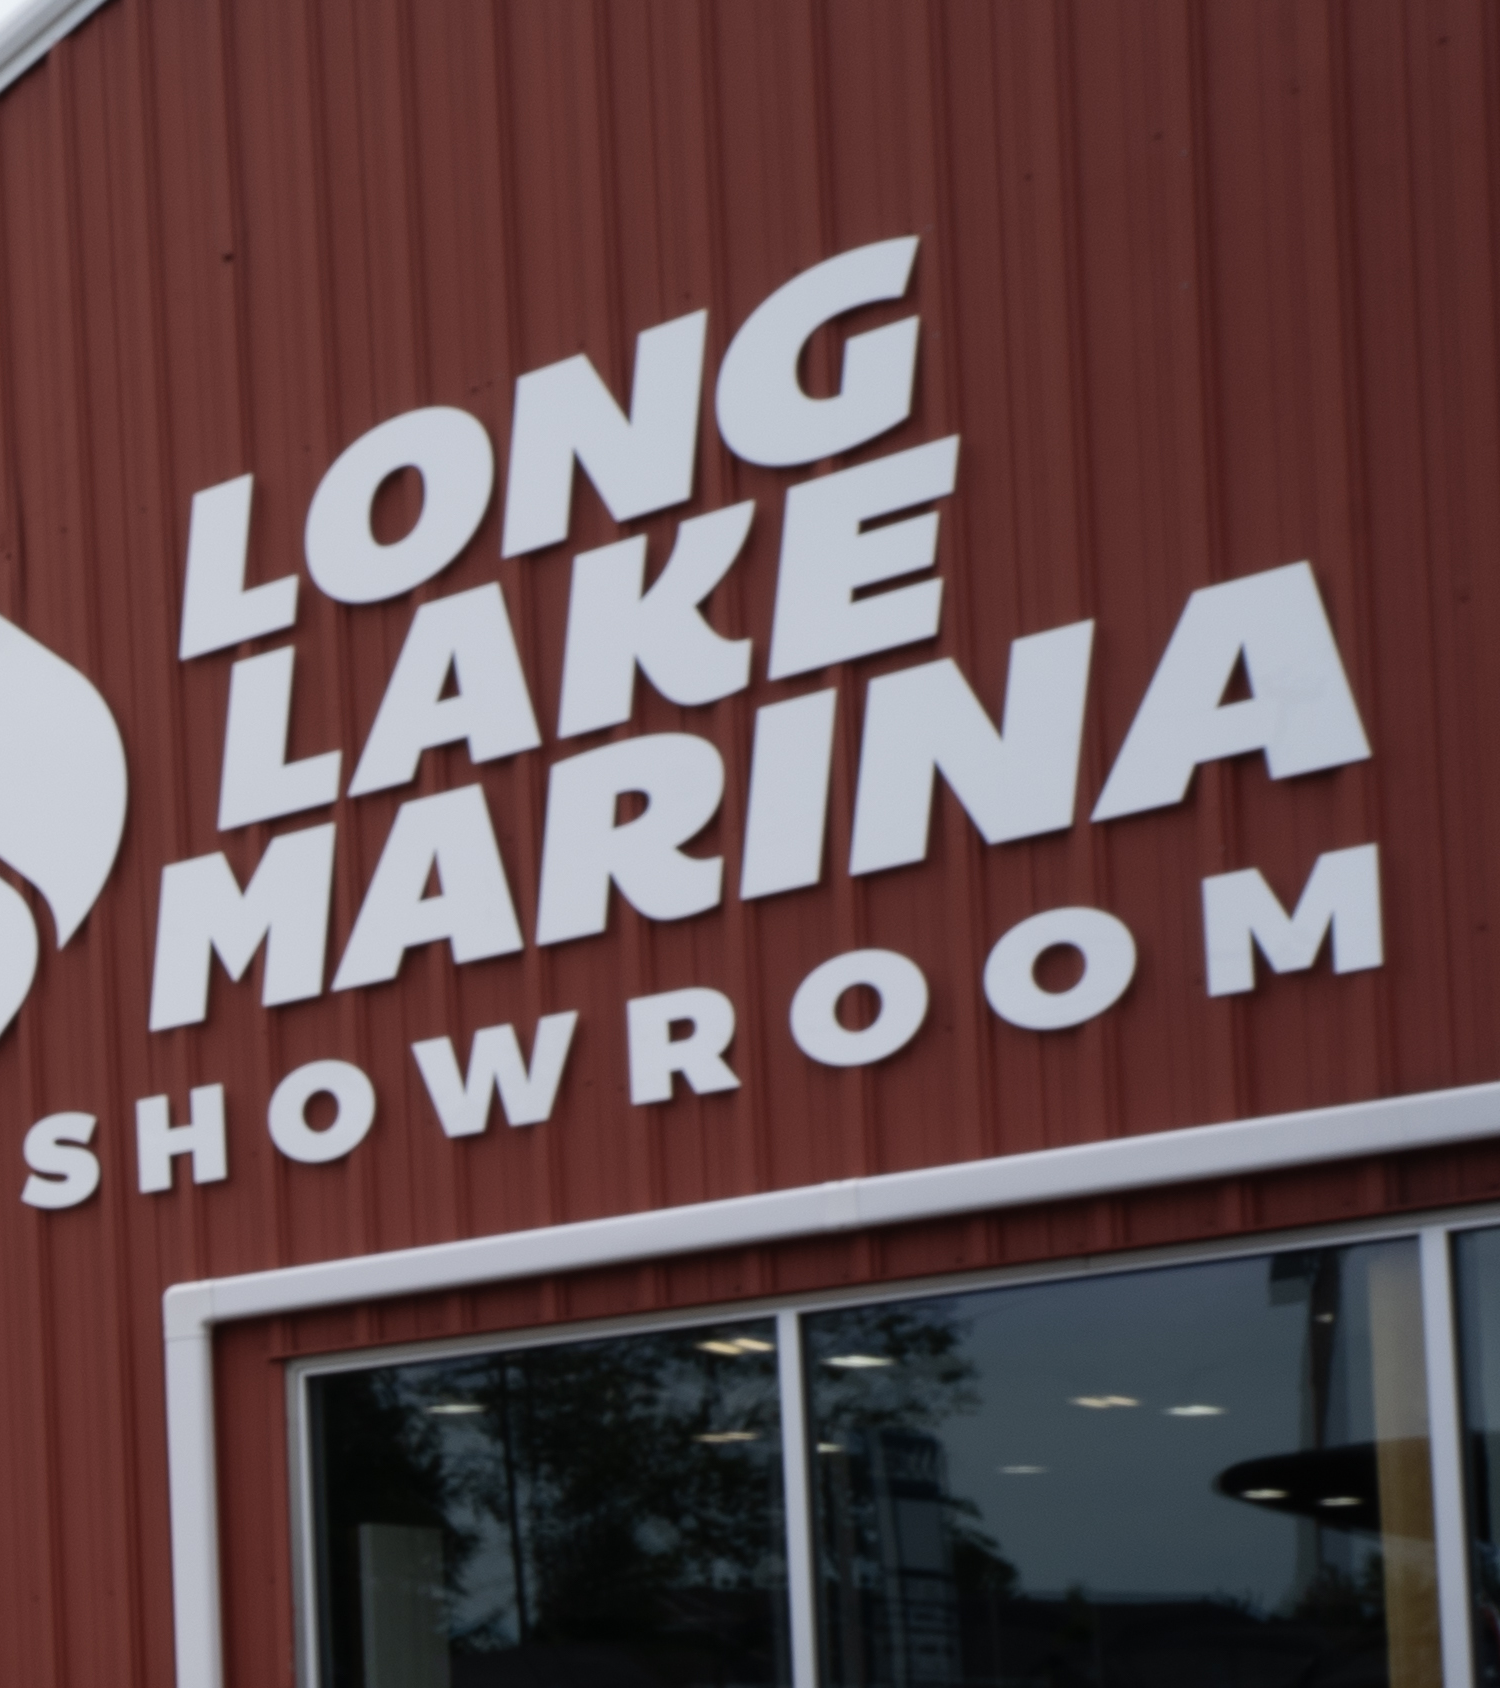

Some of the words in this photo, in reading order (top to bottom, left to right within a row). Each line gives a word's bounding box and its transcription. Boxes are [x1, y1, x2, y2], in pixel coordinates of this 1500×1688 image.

[180, 236, 919, 659] LONG
[219, 436, 959, 831] LAKE
[149, 562, 1370, 1031] MARINA
[22, 844, 1382, 1208] SHOWROOM
